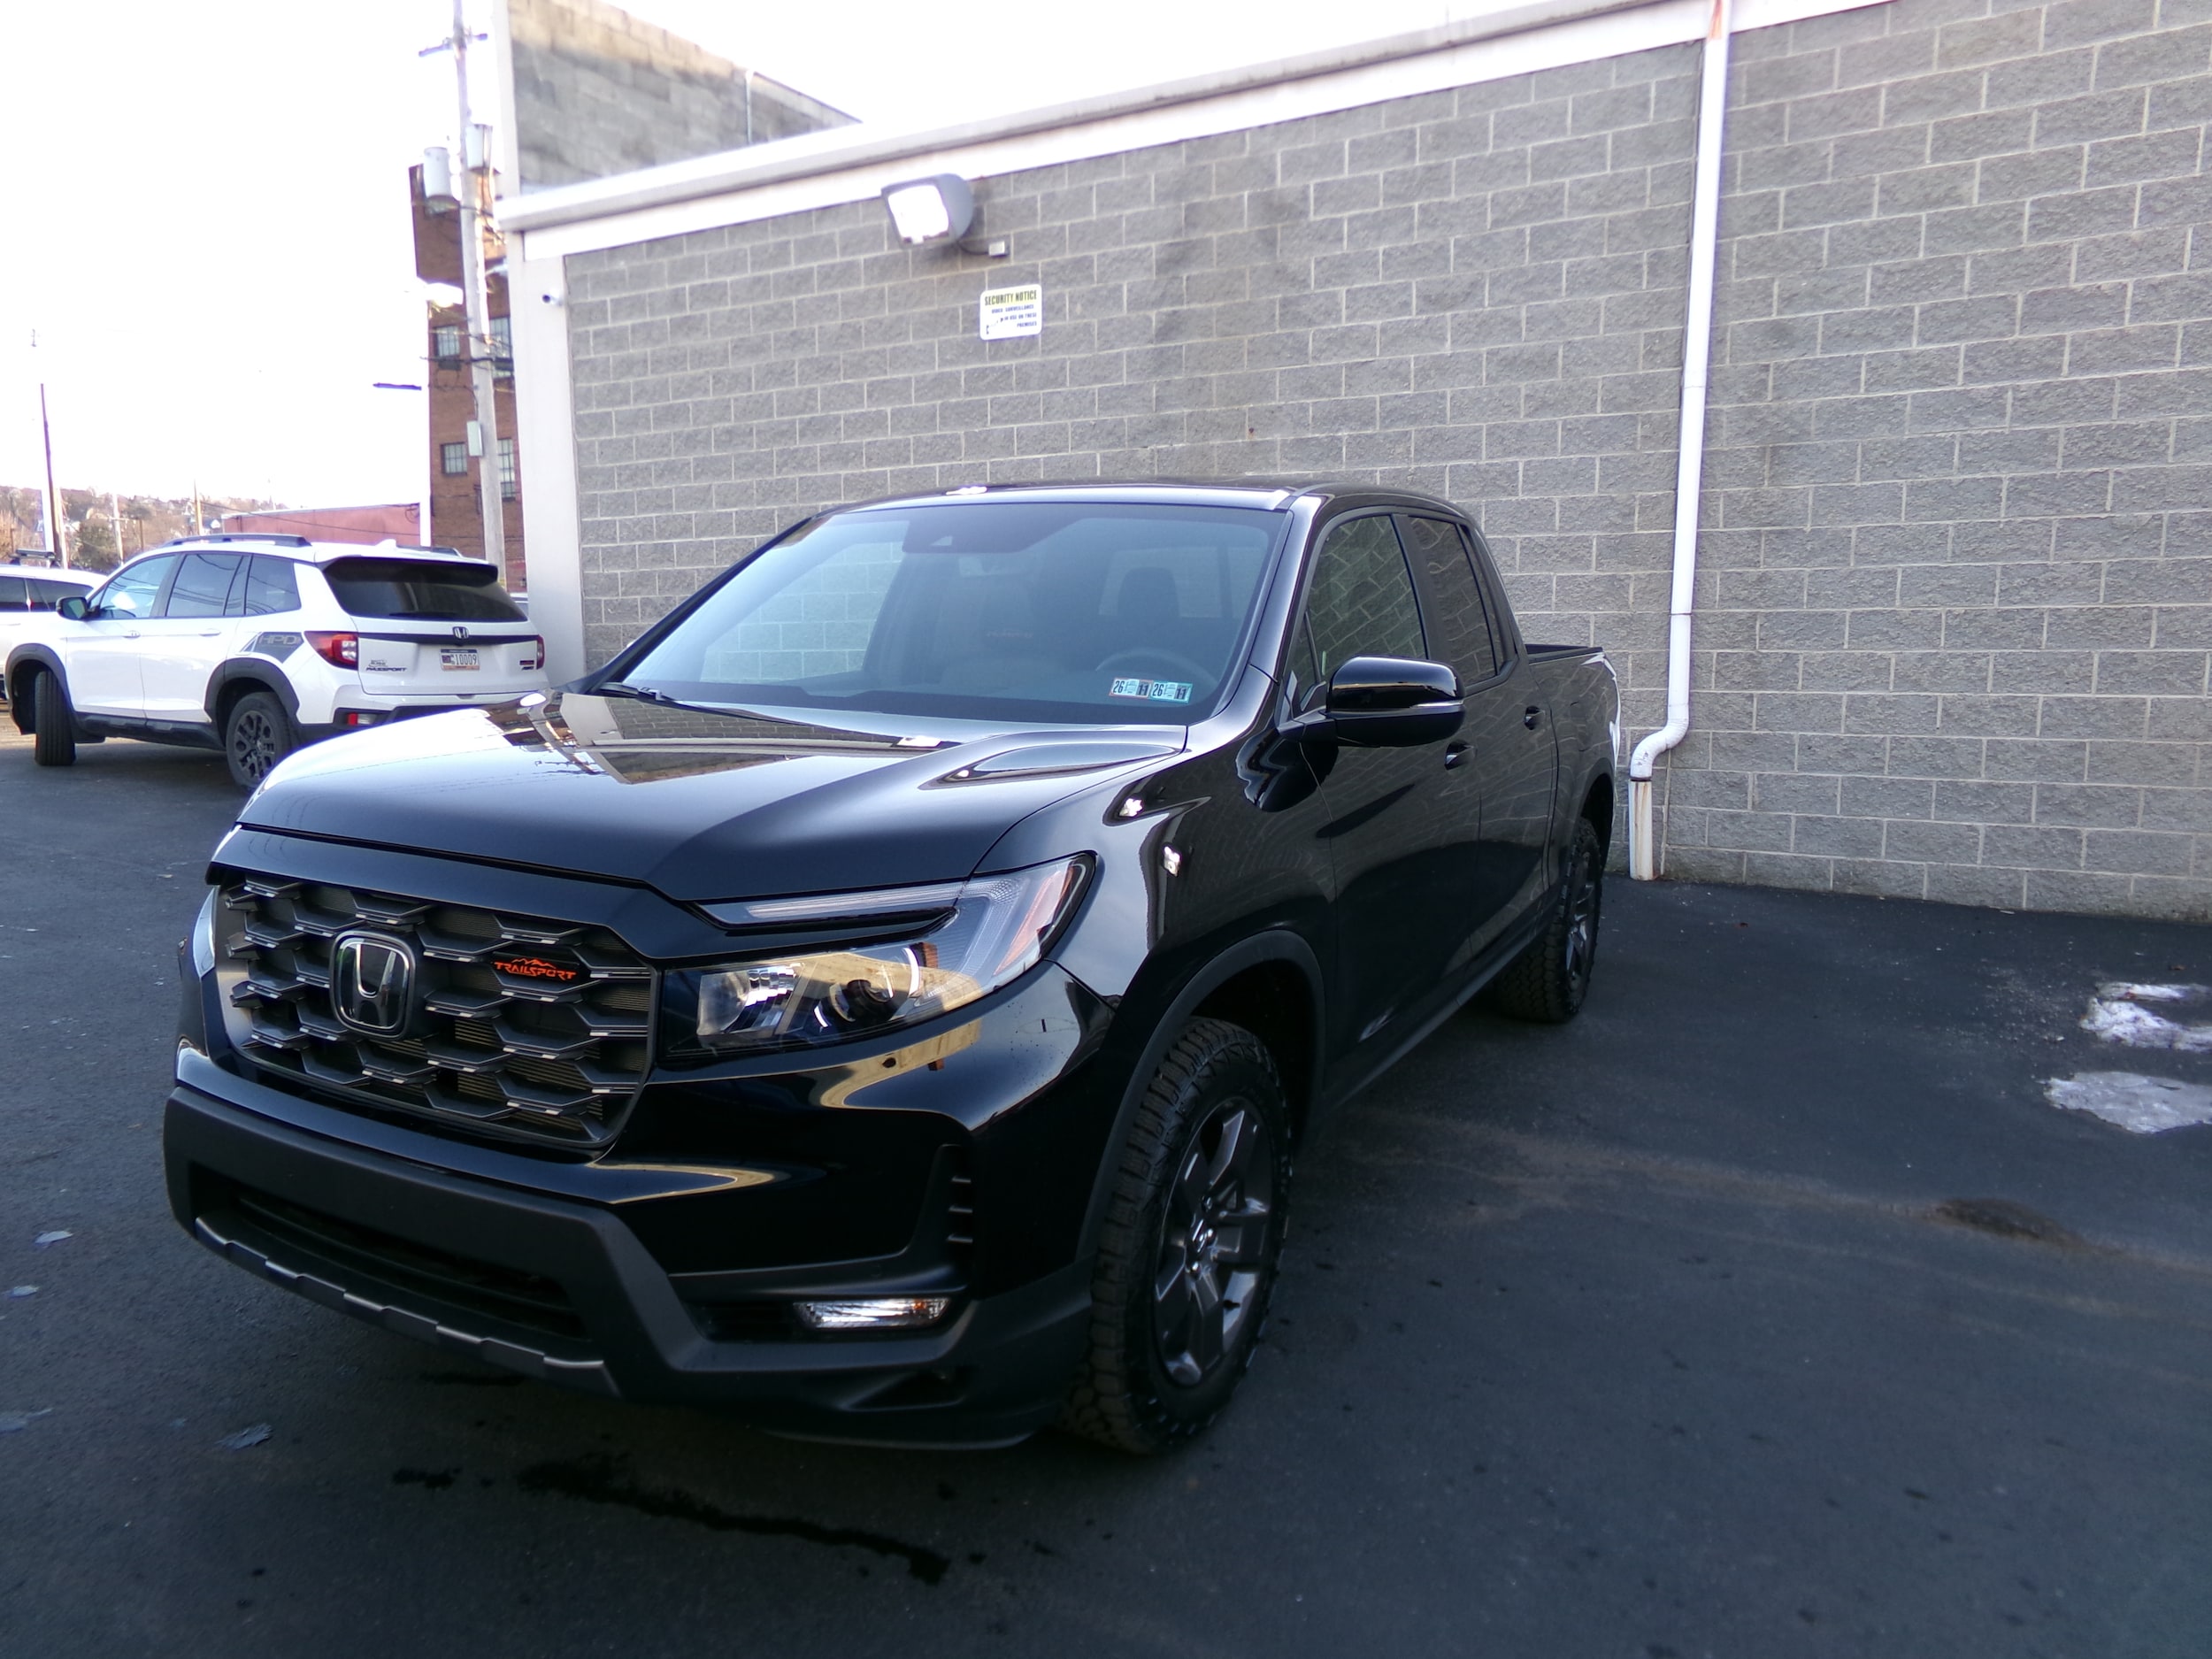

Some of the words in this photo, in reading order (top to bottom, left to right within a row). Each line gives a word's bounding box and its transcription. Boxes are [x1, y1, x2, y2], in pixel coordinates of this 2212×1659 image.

[985, 293, 1014, 306] SECURITY
[1015, 289, 1037, 302] NOTICE
[1112, 680, 1125, 694] 26
[1138, 684, 1148, 695] 11
[1152, 683, 1164, 696] 26
[1176, 687, 1187, 699] 11
[494, 962, 576, 981] TRAILSPORT
